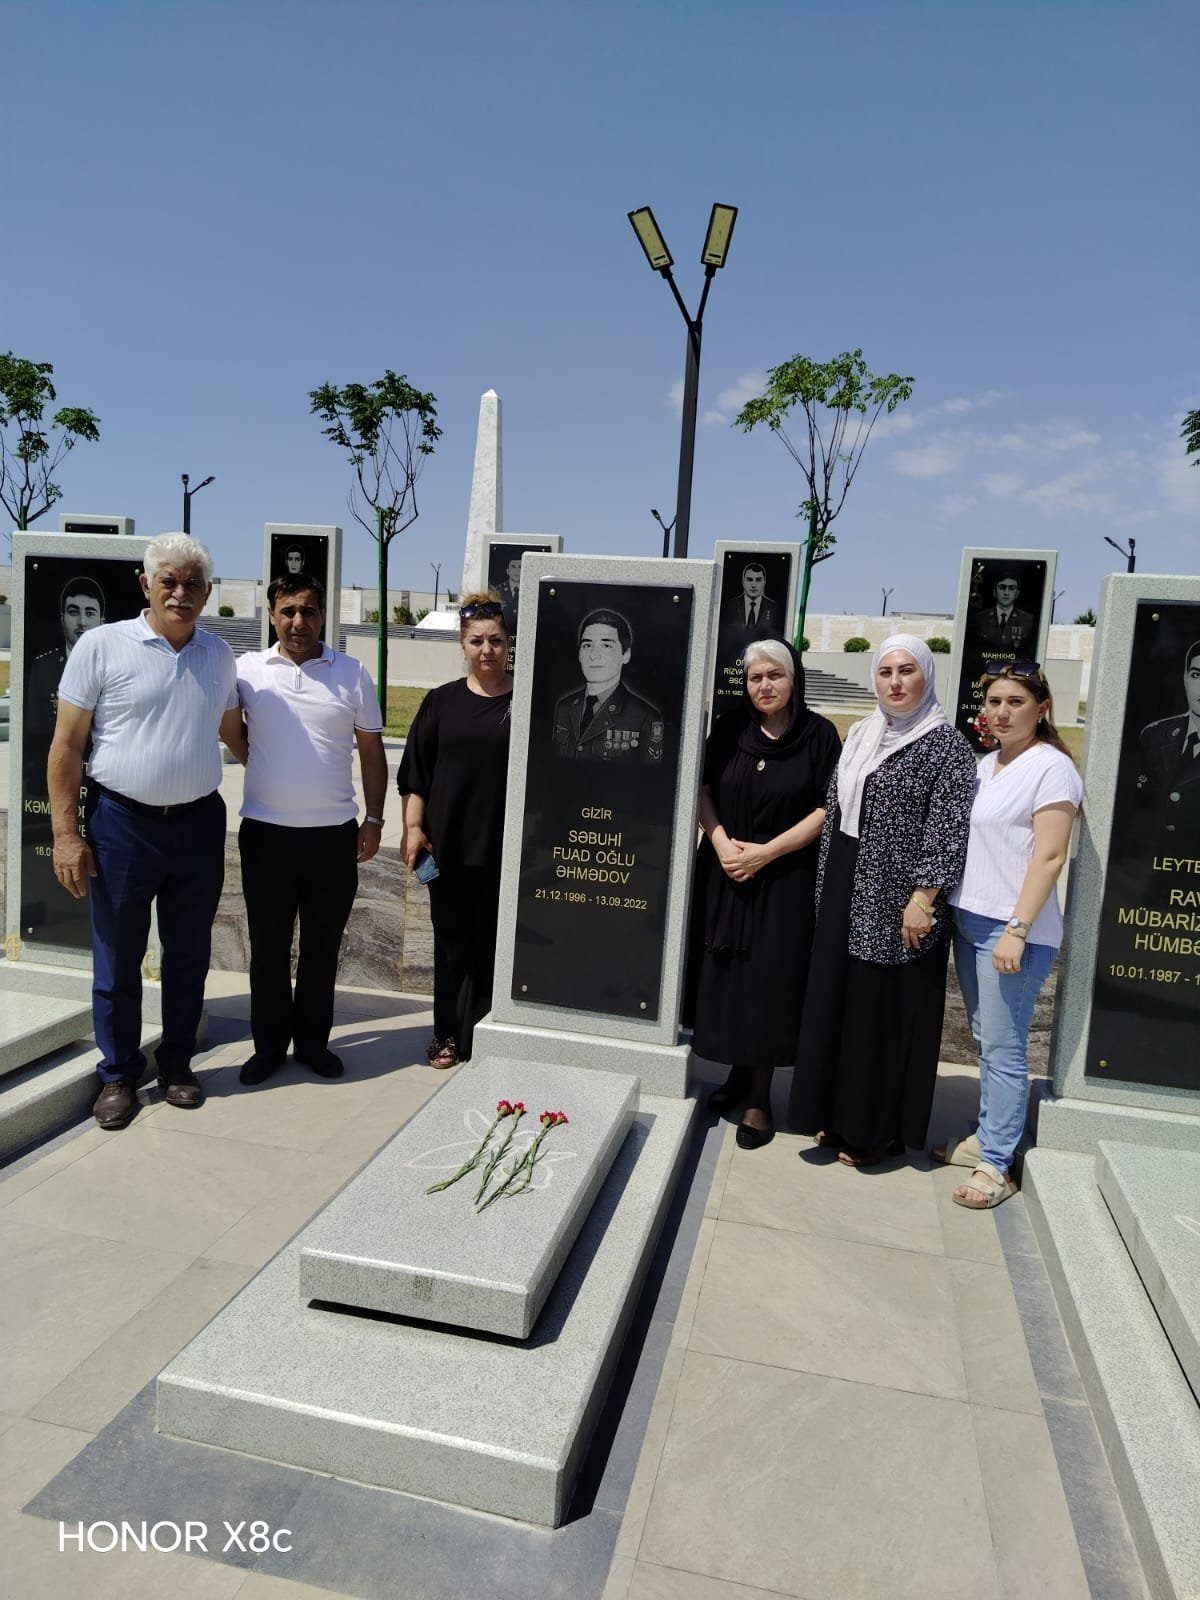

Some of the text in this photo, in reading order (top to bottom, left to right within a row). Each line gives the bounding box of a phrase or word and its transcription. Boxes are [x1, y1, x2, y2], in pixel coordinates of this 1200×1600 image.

[581, 806, 612, 820] GİZİR
[568, 830, 622, 847] SƏBUHİ
[553, 846, 635, 867] FUAD OĞLU
[556, 865, 630, 884] ƏHMƏDOV
[535, 888, 586, 903] 21.12.1996
[595, 895, 647, 910] 13.09.2022
[1109, 964, 1181, 983] 10.01.1987
